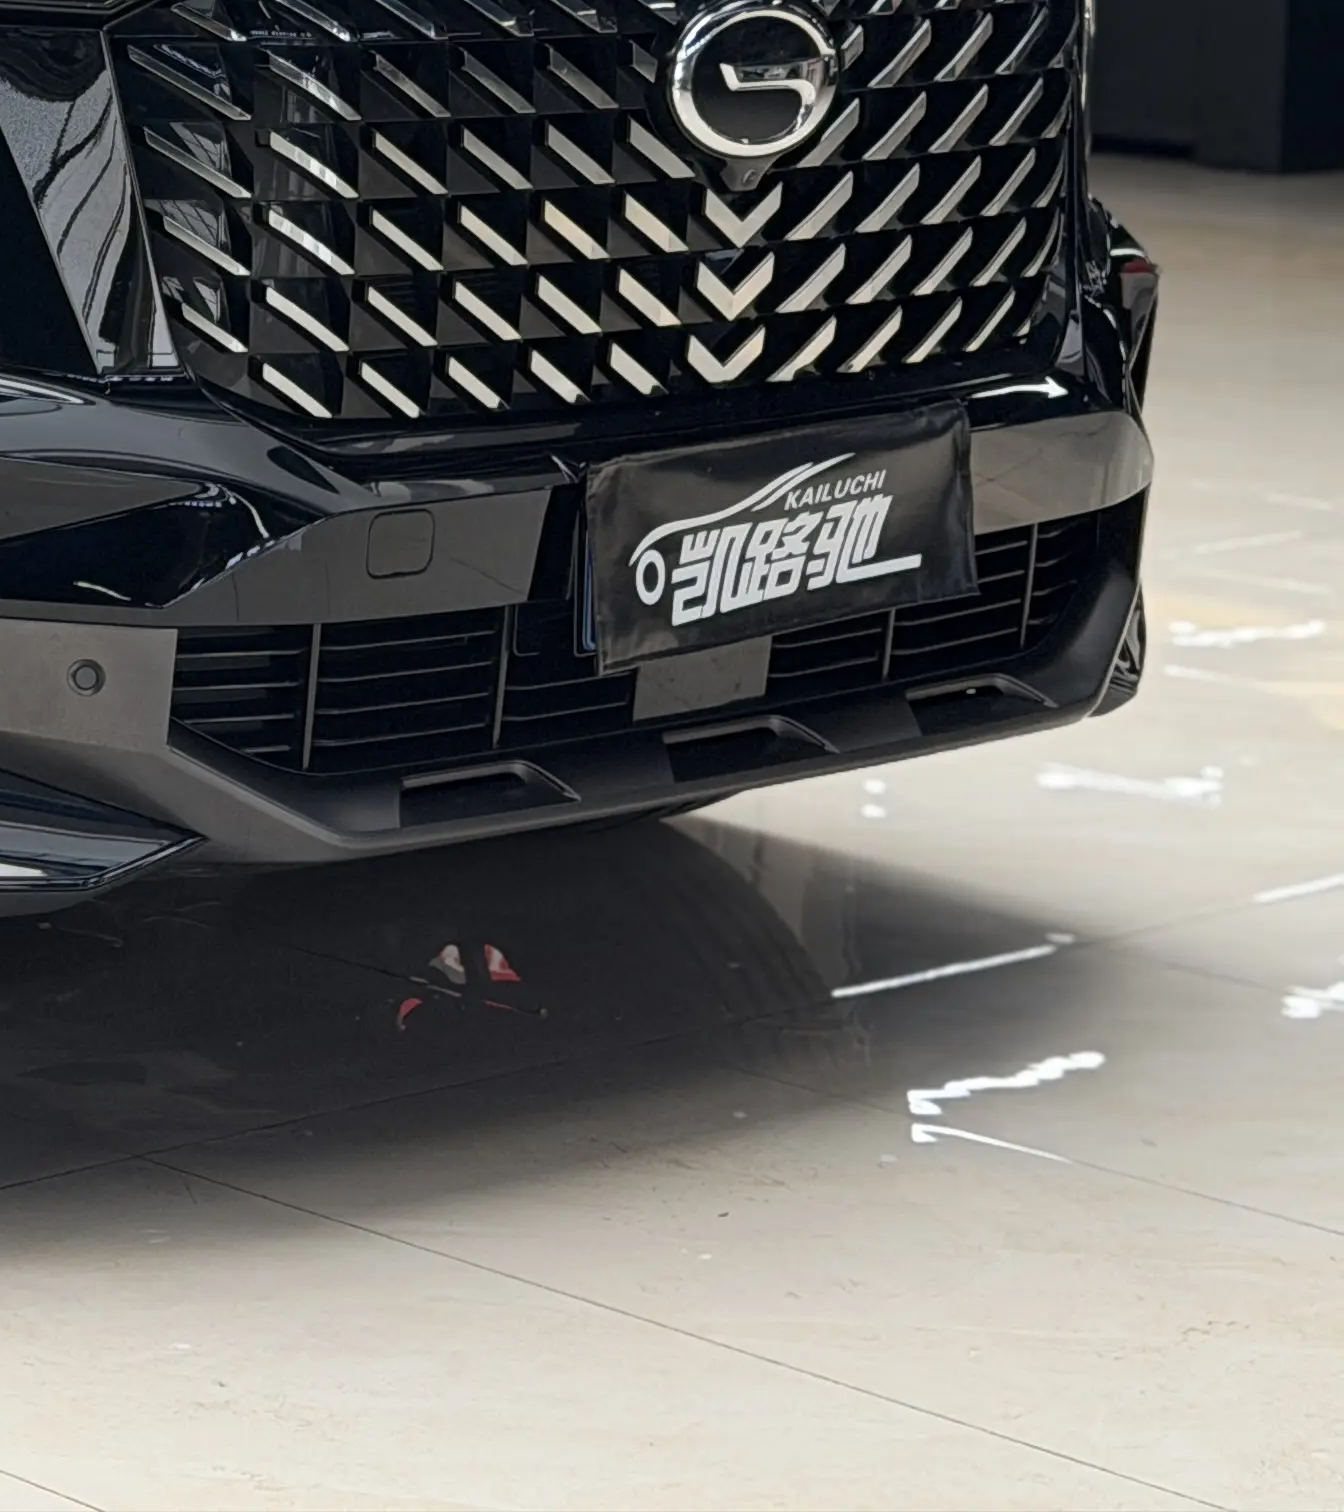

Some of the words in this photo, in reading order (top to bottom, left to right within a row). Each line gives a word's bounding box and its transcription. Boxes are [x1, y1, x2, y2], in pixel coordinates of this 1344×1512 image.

[783, 469, 888, 512] KAILUCHI
[671, 494, 923, 627] 凯路驰
